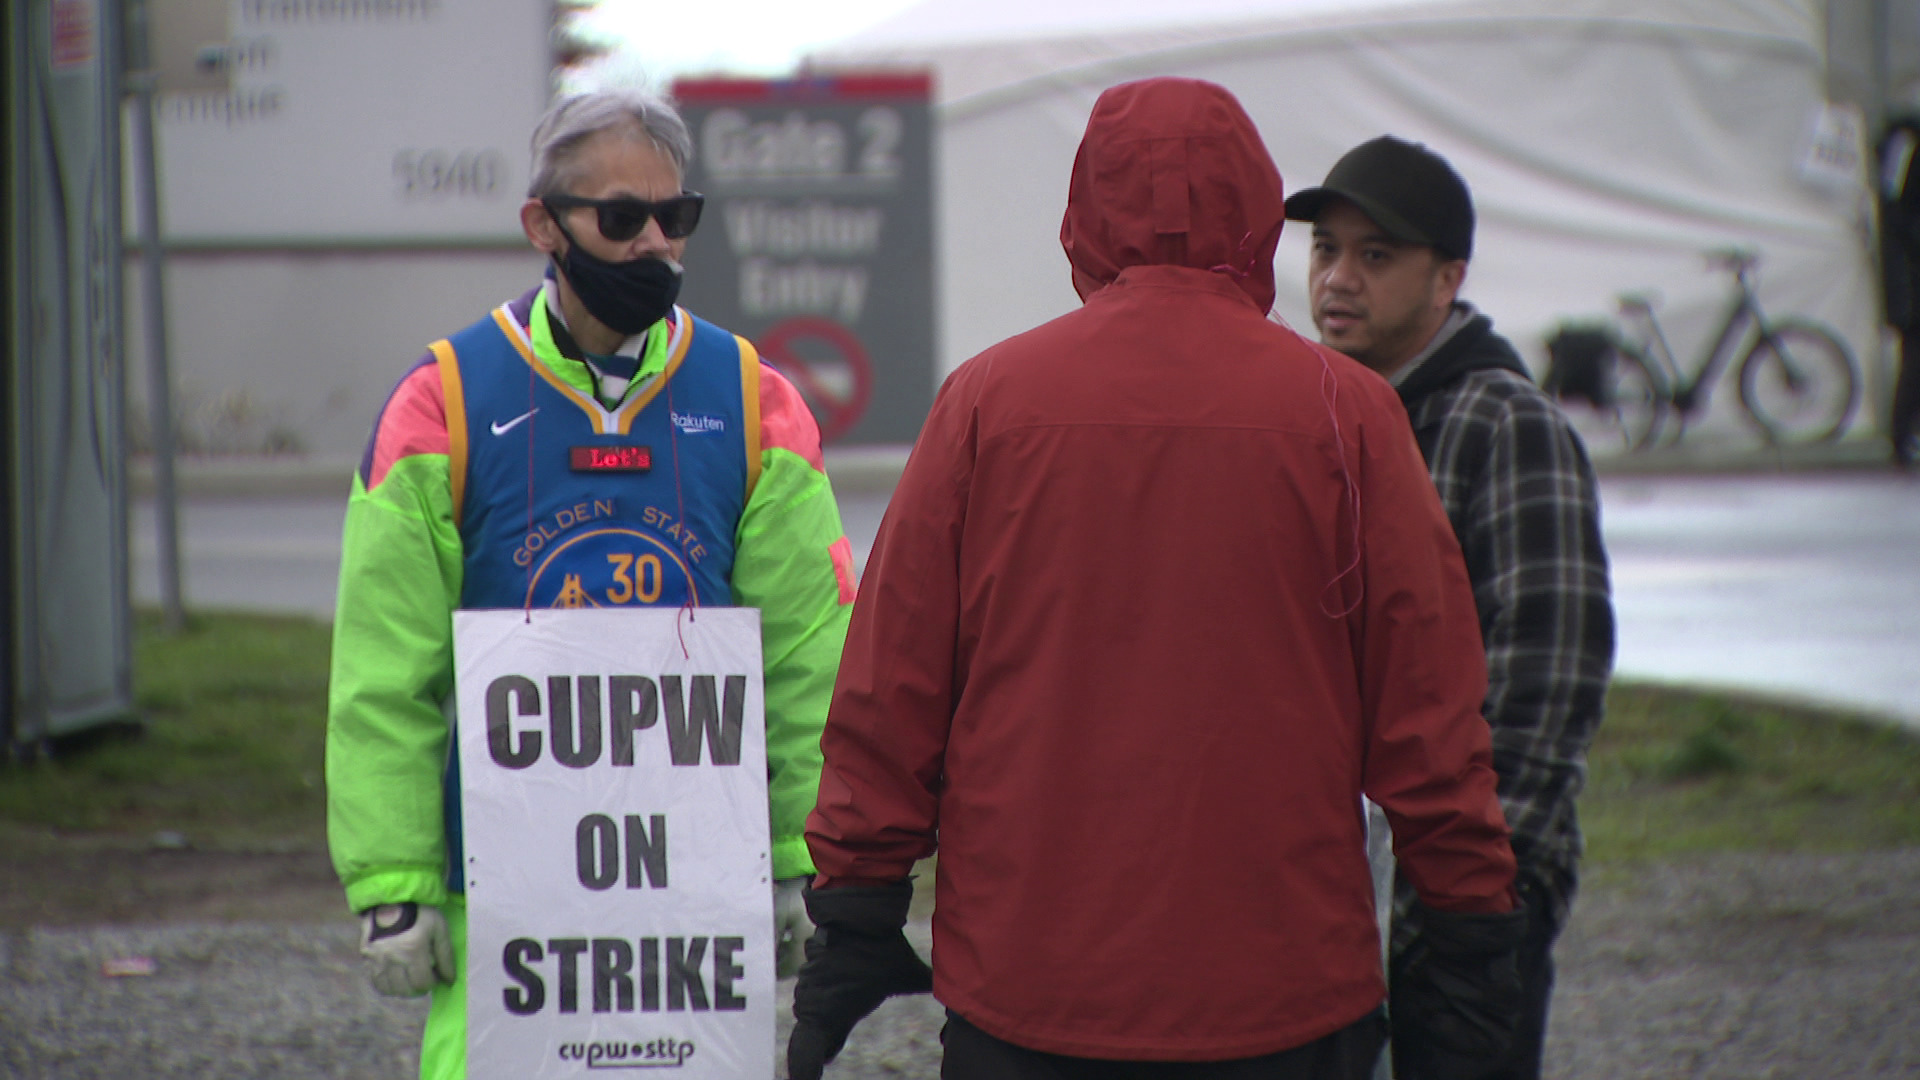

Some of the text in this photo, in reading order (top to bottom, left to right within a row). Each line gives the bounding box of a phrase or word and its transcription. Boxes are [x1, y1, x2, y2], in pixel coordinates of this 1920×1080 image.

[704, 106, 901, 178] Gate 2
[724, 202, 885, 252] Visitor
[738, 258, 866, 322] Entry
[671, 411, 725, 432] Rakuten
[590, 448, 650, 468] Let's
[513, 499, 708, 566] GOLDEN STATE
[606, 553, 662, 604] 30
[485, 675, 746, 769] CUPW
[576, 813, 668, 890] ON
[502, 936, 746, 1015] STRIKE
